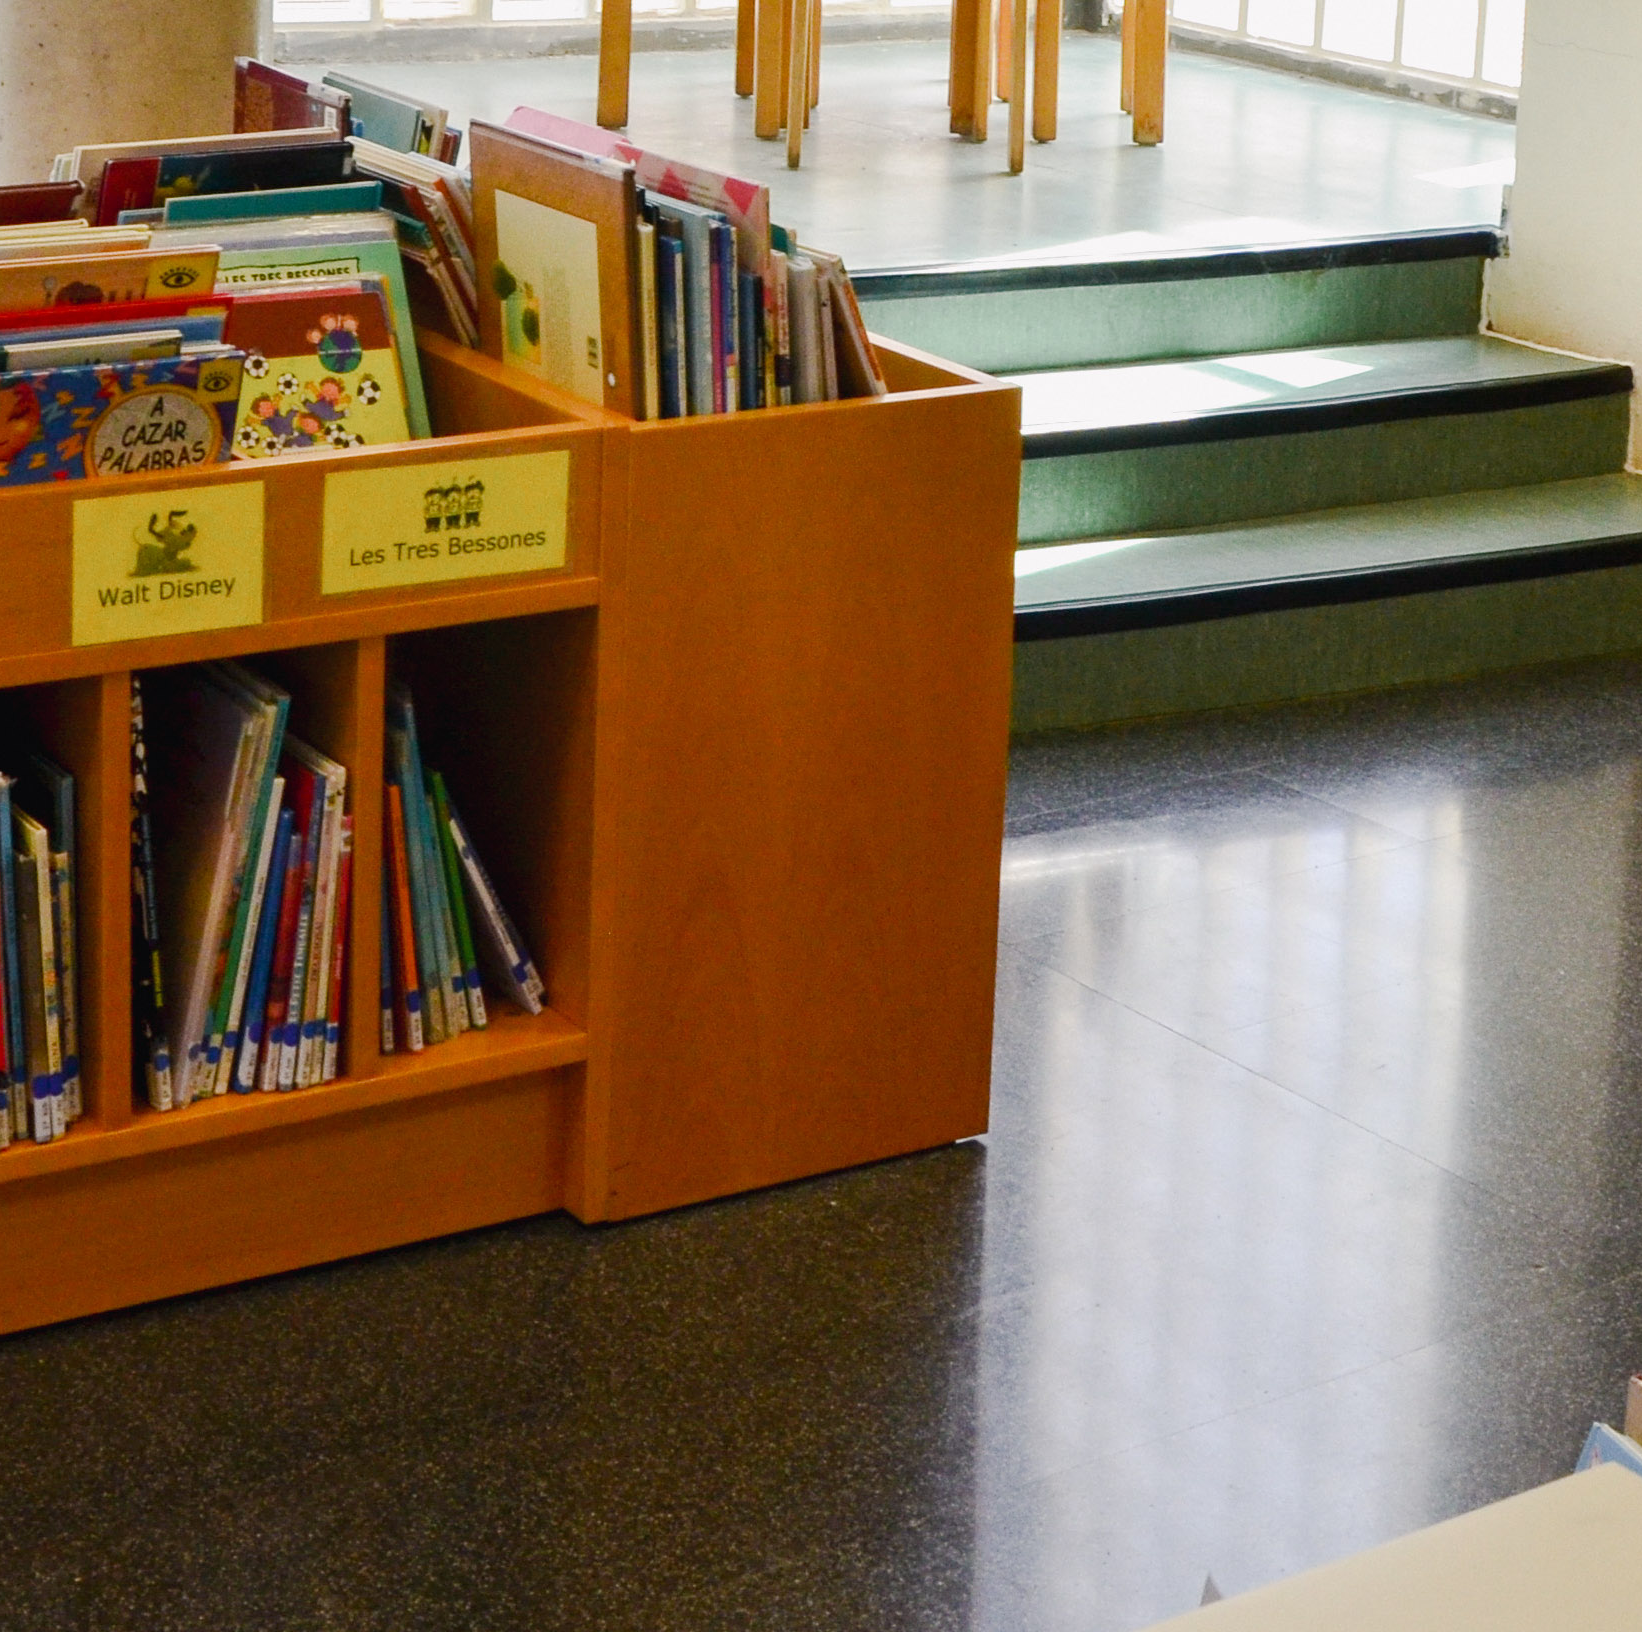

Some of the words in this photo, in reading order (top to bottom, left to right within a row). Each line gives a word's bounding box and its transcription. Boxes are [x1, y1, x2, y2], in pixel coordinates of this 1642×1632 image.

[150, 396, 164, 417] A
[122, 420, 187, 447] CAZAR
[97, 441, 206, 473] PALABRAS
[350, 548, 385, 566] Les
[394, 542, 440, 561] Tres
[448, 530, 546, 556] Bessones
[98, 584, 150, 607] Walt
[159, 577, 236, 600] Disney
